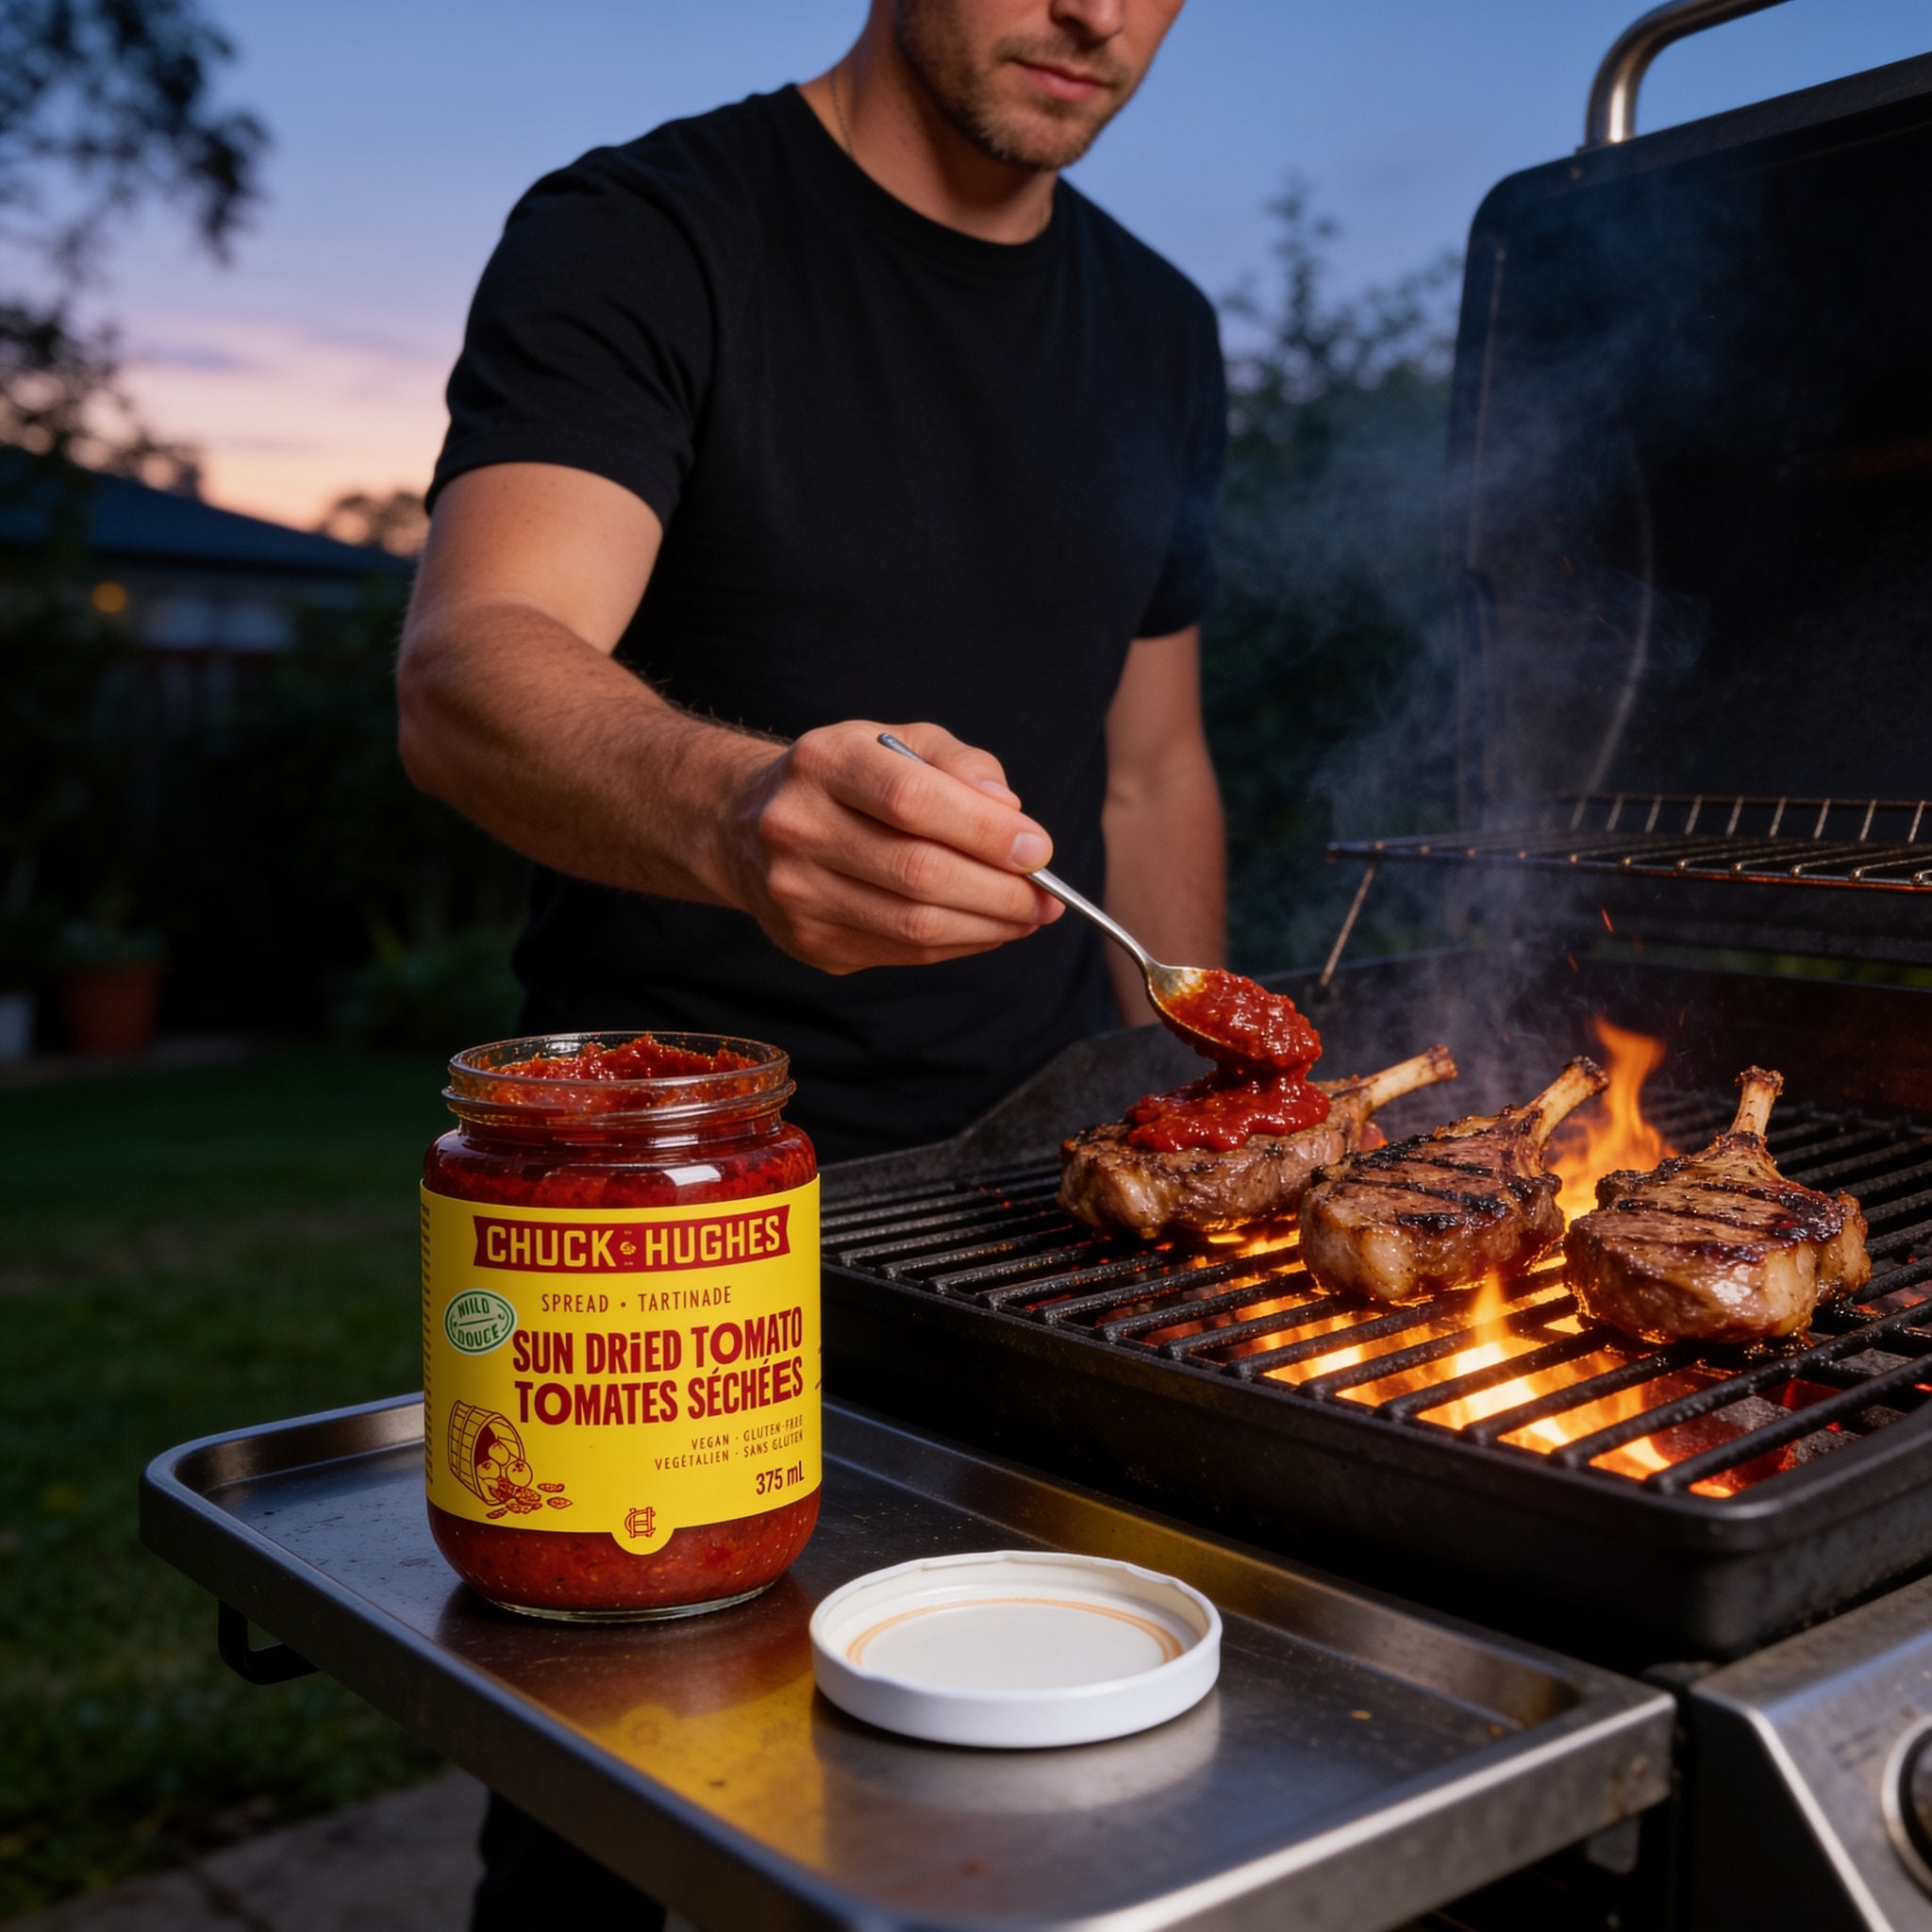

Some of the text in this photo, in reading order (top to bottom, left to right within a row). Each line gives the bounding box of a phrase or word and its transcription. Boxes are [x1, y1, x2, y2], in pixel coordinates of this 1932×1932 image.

[487, 1215, 780, 1267] CHUCK HUGHES
[541, 1285, 732, 1313] SPREAD TARTINADE
[458, 1324, 499, 1347] DOUCE
[512, 1329, 574, 1374] SUN
[691, 1306, 802, 1368] TOMATO
[514, 1356, 803, 1425] TOMATES SÉCHÉES
[691, 1434, 729, 1450] VEGAN
[743, 1441, 769, 1457] SANS
[772, 1429, 803, 1451] GLUTEN
[756, 1460, 805, 1495] 375 mL
